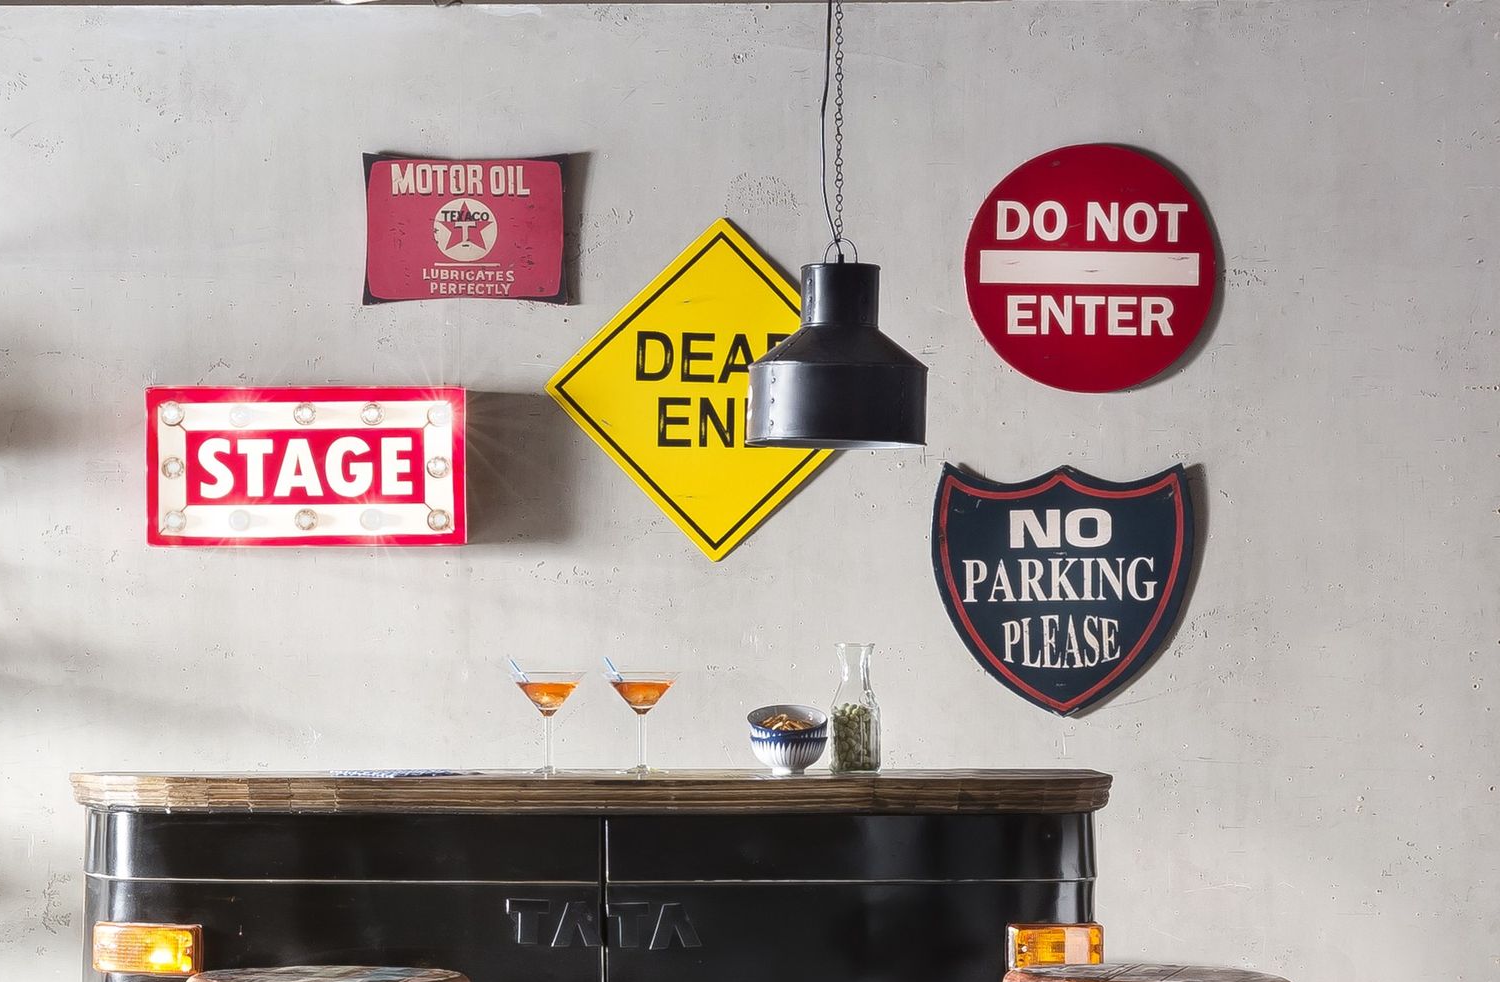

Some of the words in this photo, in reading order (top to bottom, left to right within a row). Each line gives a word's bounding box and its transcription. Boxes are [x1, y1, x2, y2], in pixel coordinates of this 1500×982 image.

[390, 163, 484, 196] MOTOR
[490, 164, 531, 196] OIL
[441, 210, 490, 222] TEXACO
[996, 200, 1068, 242] DO
[1086, 201, 1189, 243] NOT
[423, 268, 515, 282] LUBRICATES
[430, 283, 512, 295] PERFECTLY
[1007, 295, 1175, 336] ENTER
[657, 397, 764, 448] EN
[197, 436, 414, 499] STAGE
[1009, 508, 1112, 549] NO
[962, 556, 1158, 602] PARKING
[1002, 614, 1121, 668] PLEASE
[506, 898, 702, 950] TATA
